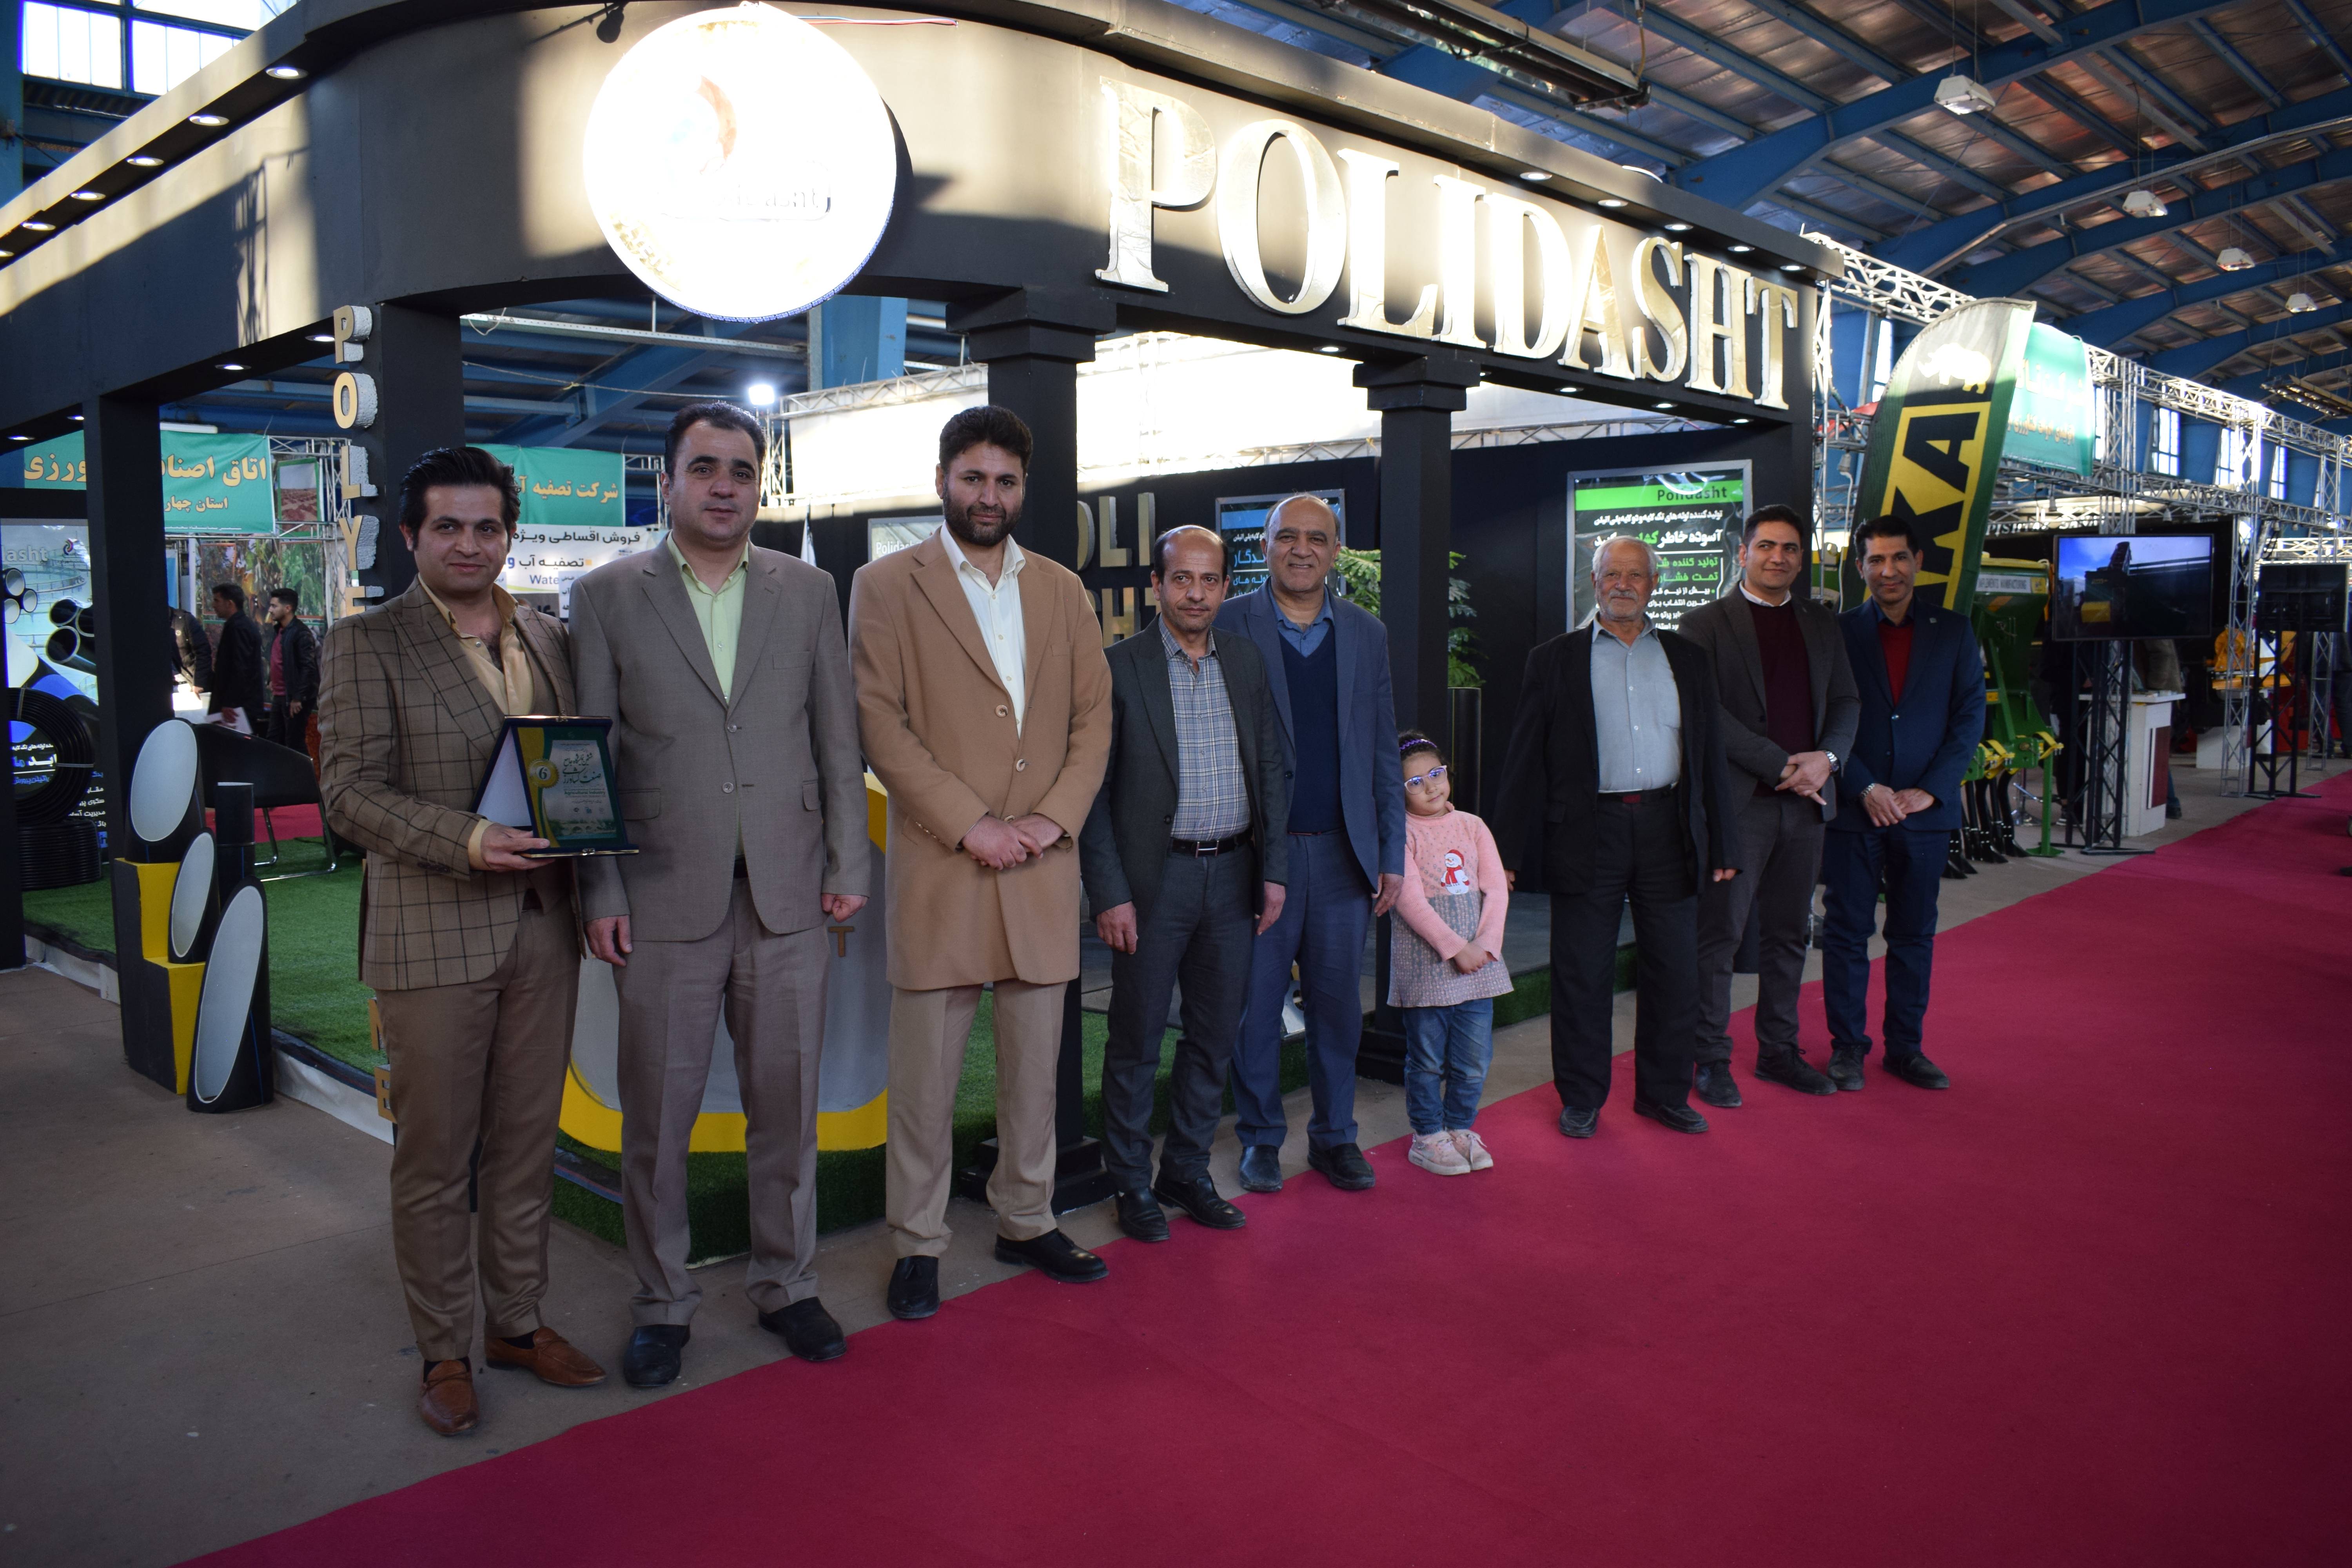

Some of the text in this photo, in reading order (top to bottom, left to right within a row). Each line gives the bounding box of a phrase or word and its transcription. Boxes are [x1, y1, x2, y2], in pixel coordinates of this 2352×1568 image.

[1095, 76, 1798, 411] POLIDASHT
[24, 453, 267, 487] اتاق اصنا ورزی
[518, 475, 619, 503] شرکت تصفیه آ
[196, 495, 229, 513] استان
[513, 526, 641, 545] فروش اقساطی ویژه
[1657, 530, 1688, 548] خاطر
[1688, 529, 1723, 546] آسوده
[519, 554, 535, 570] آب
[539, 557, 584, 570] تصفیه
[1697, 557, 1718, 568] تولید
[530, 574, 559, 584] Wate
[539, 767, 547, 780] 6
